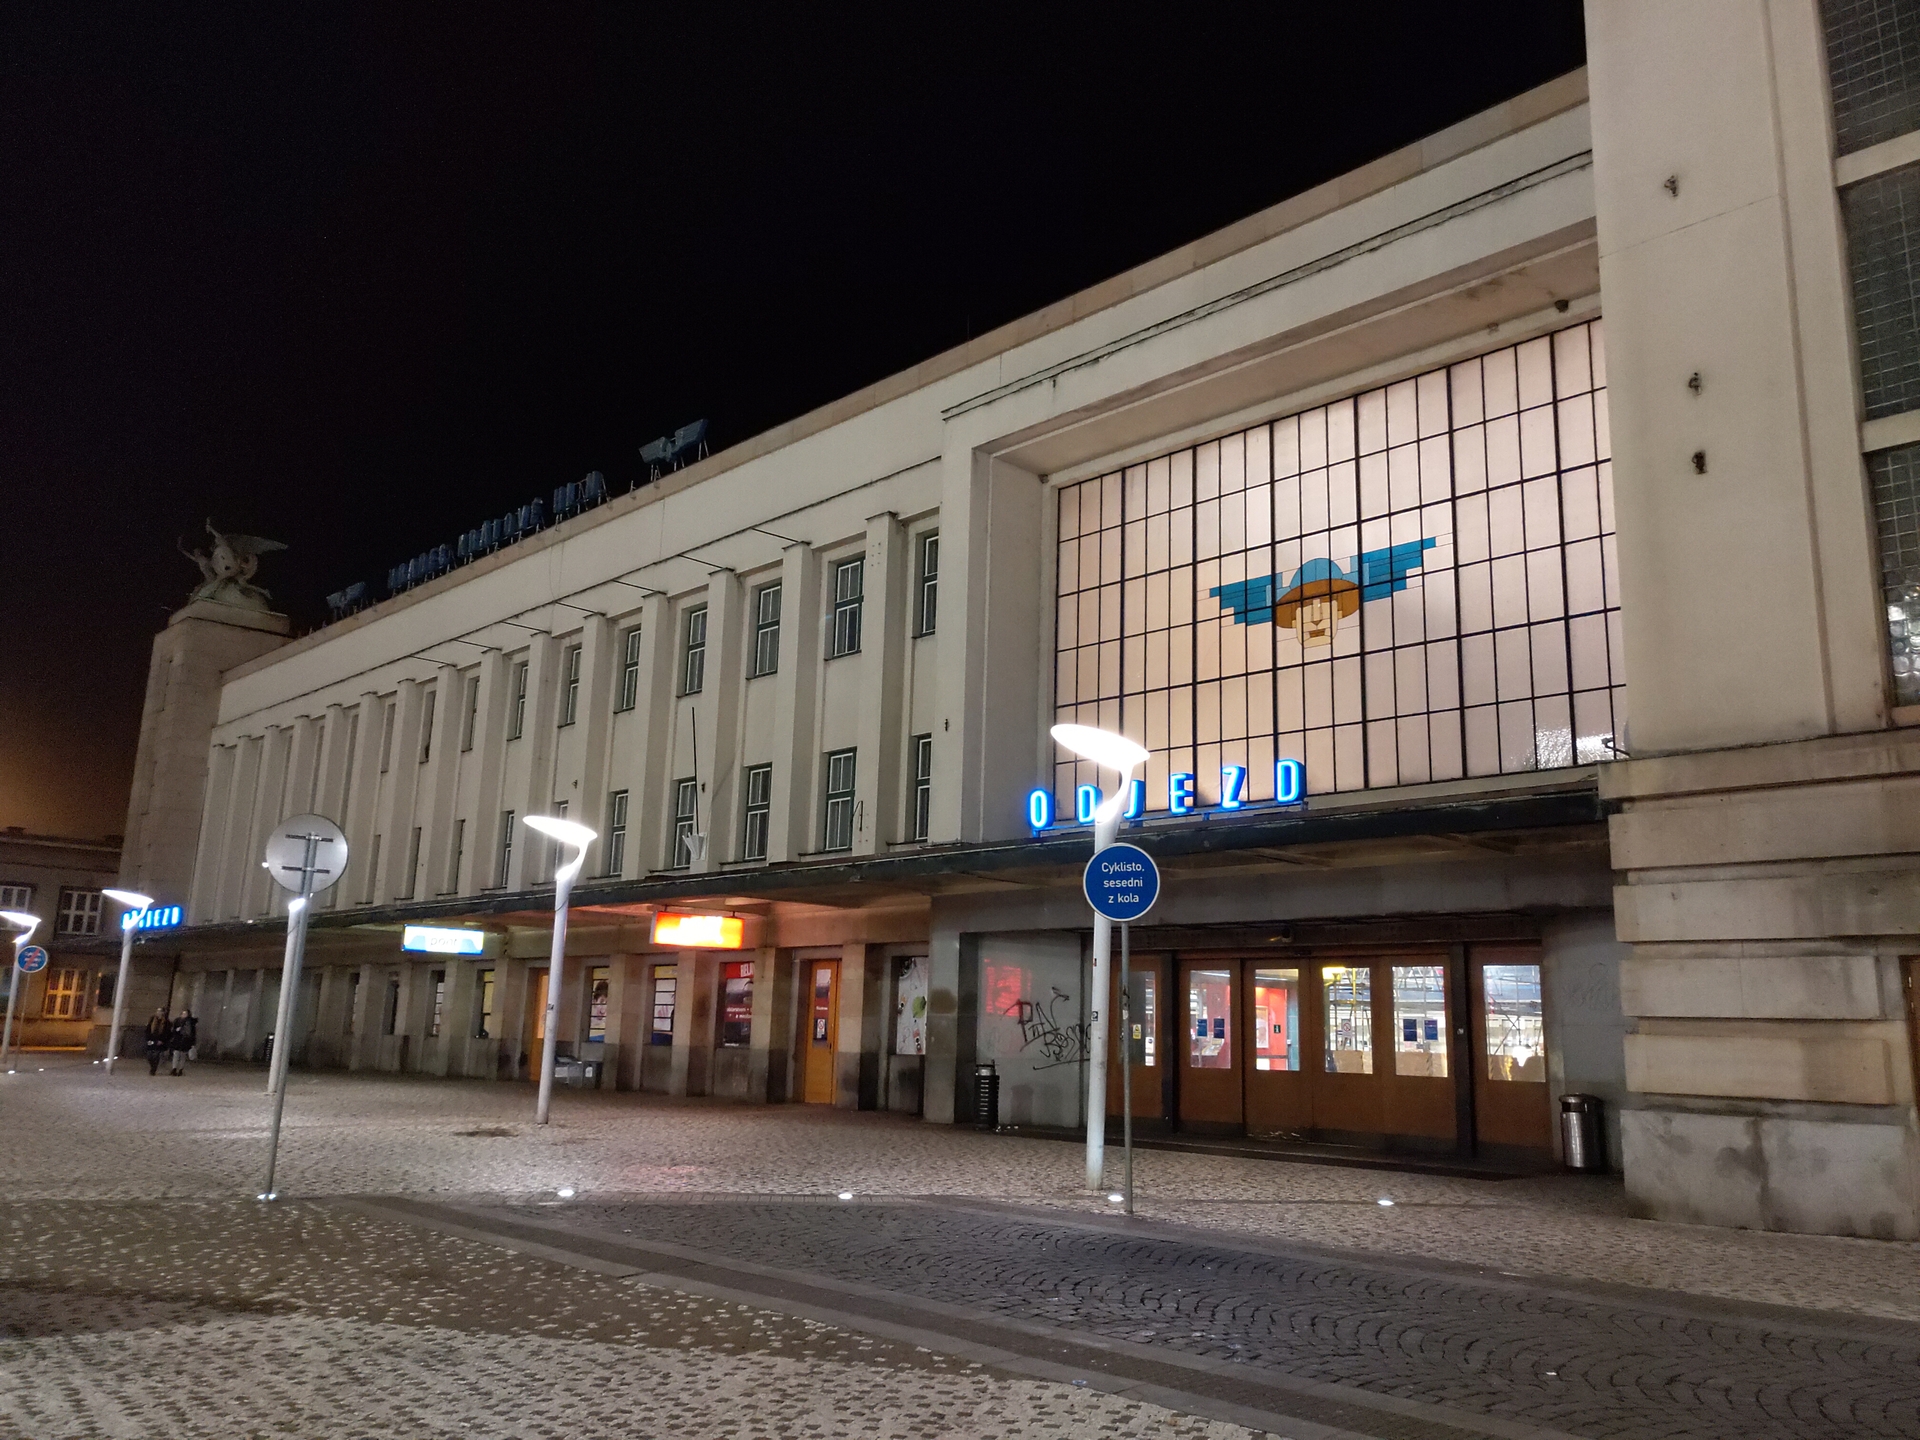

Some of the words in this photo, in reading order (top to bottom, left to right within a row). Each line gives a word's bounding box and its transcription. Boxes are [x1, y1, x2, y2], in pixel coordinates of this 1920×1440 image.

[1028, 758, 1307, 830] ODJEZD
[1103, 877, 1143, 888] sesedni
[1108, 895, 1115, 903] z
[1117, 893, 1140, 903] kola
